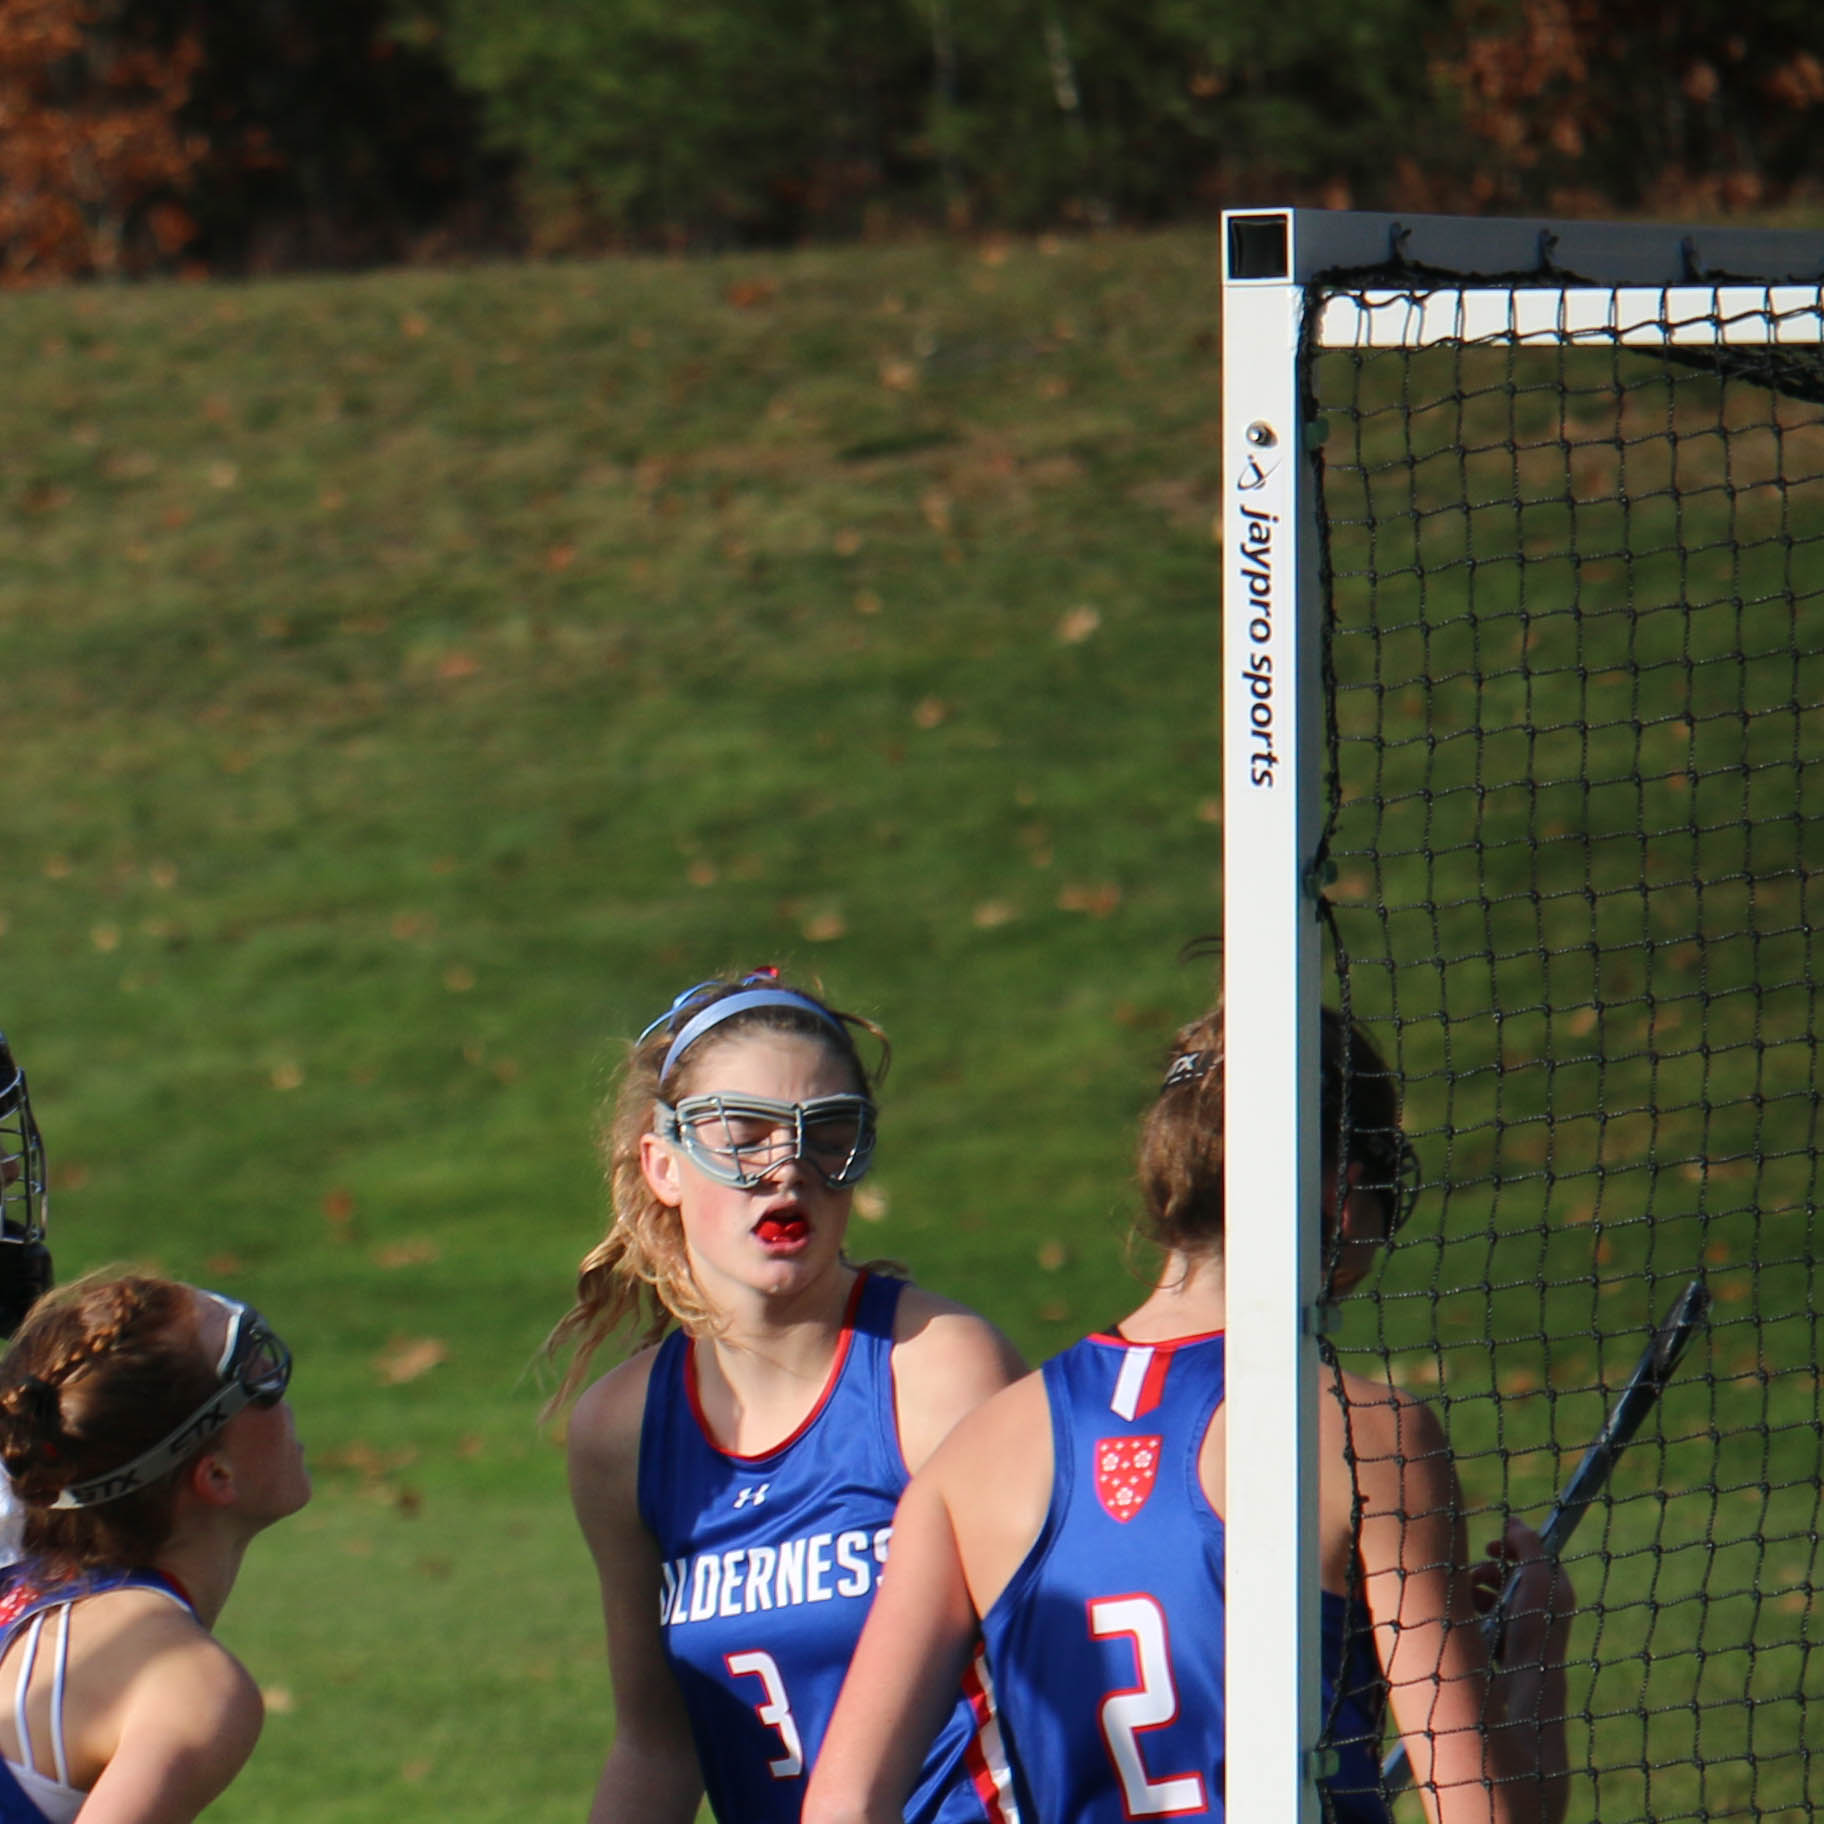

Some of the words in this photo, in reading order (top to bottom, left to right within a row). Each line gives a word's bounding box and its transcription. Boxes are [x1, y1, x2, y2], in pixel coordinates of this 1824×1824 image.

[1240, 505, 1279, 644] jaypro
[1242, 652, 1279, 788] sports
[723, 1648, 803, 1781] 3
[1085, 1592, 1209, 1822] 2
